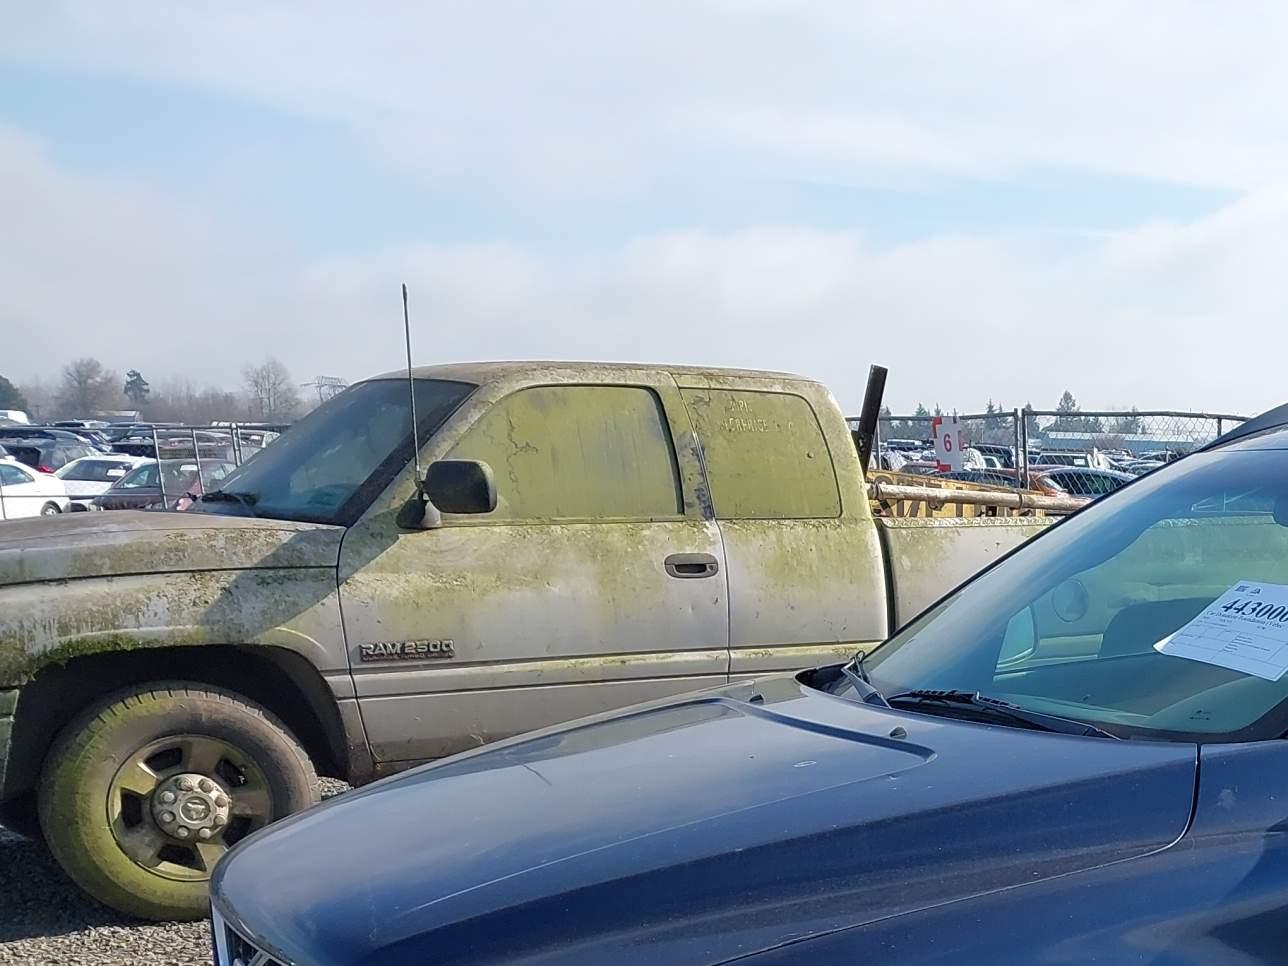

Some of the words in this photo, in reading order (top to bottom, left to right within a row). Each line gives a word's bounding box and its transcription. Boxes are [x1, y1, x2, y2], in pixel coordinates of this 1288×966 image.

[943, 433, 951, 452] 6
[360, 641, 401, 656] RAM
[404, 640, 455, 654] 2500
